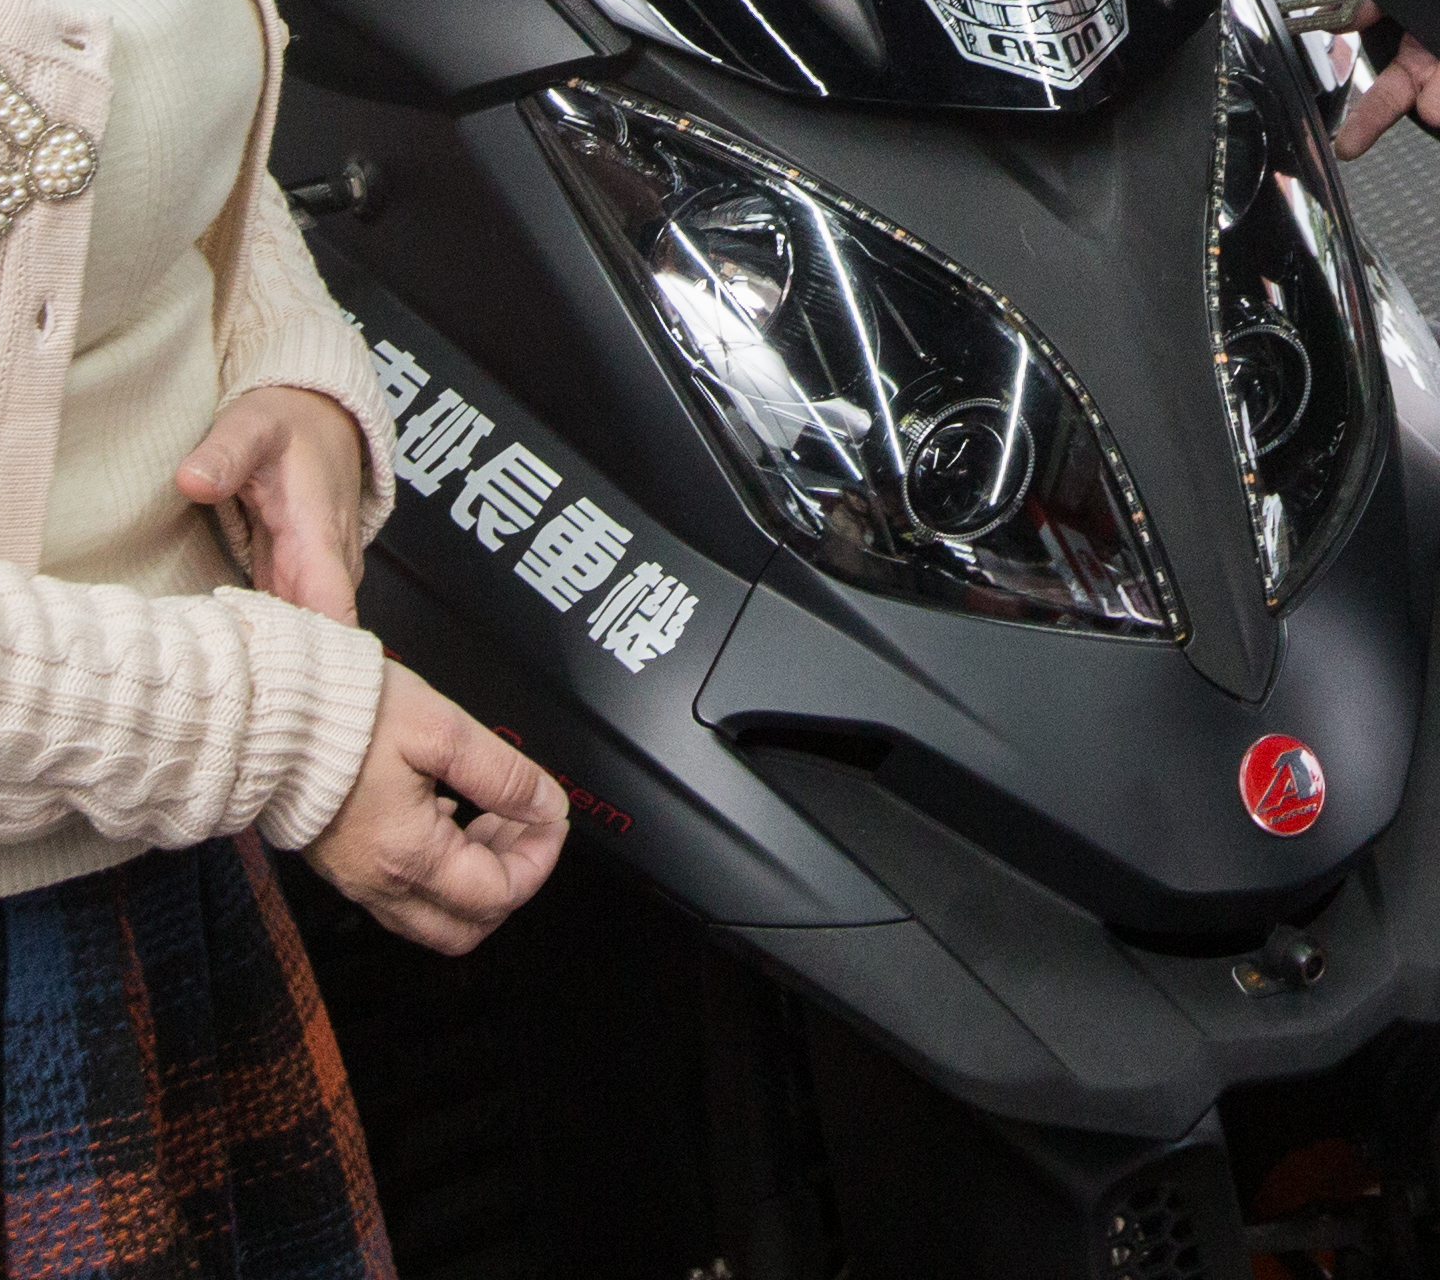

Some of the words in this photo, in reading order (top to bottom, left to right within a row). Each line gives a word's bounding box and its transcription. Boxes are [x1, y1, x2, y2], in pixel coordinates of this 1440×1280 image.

[341, 307, 700, 675] 車班長重機
